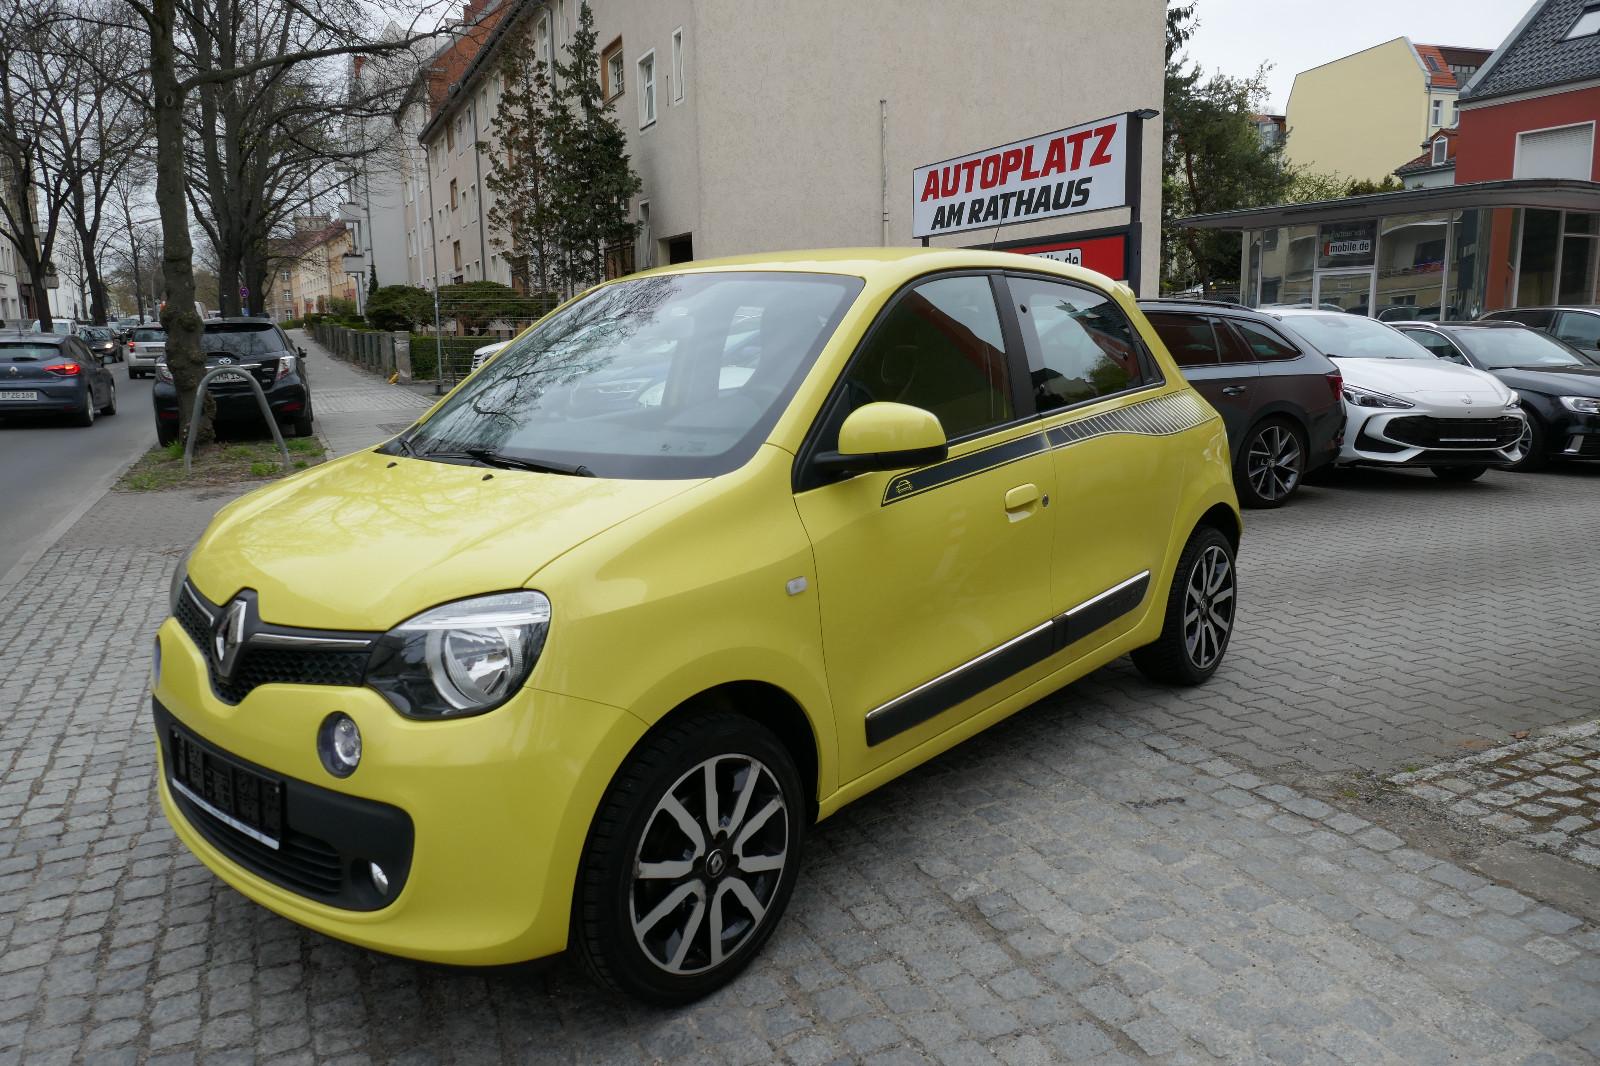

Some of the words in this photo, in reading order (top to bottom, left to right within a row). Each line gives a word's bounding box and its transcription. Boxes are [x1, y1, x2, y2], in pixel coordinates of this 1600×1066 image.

[920, 122, 1118, 203] AUTOPLATZ
[930, 201, 966, 231] AM
[967, 176, 1093, 225] RATHAUS
[1330, 241, 1369, 253] mobile.de
